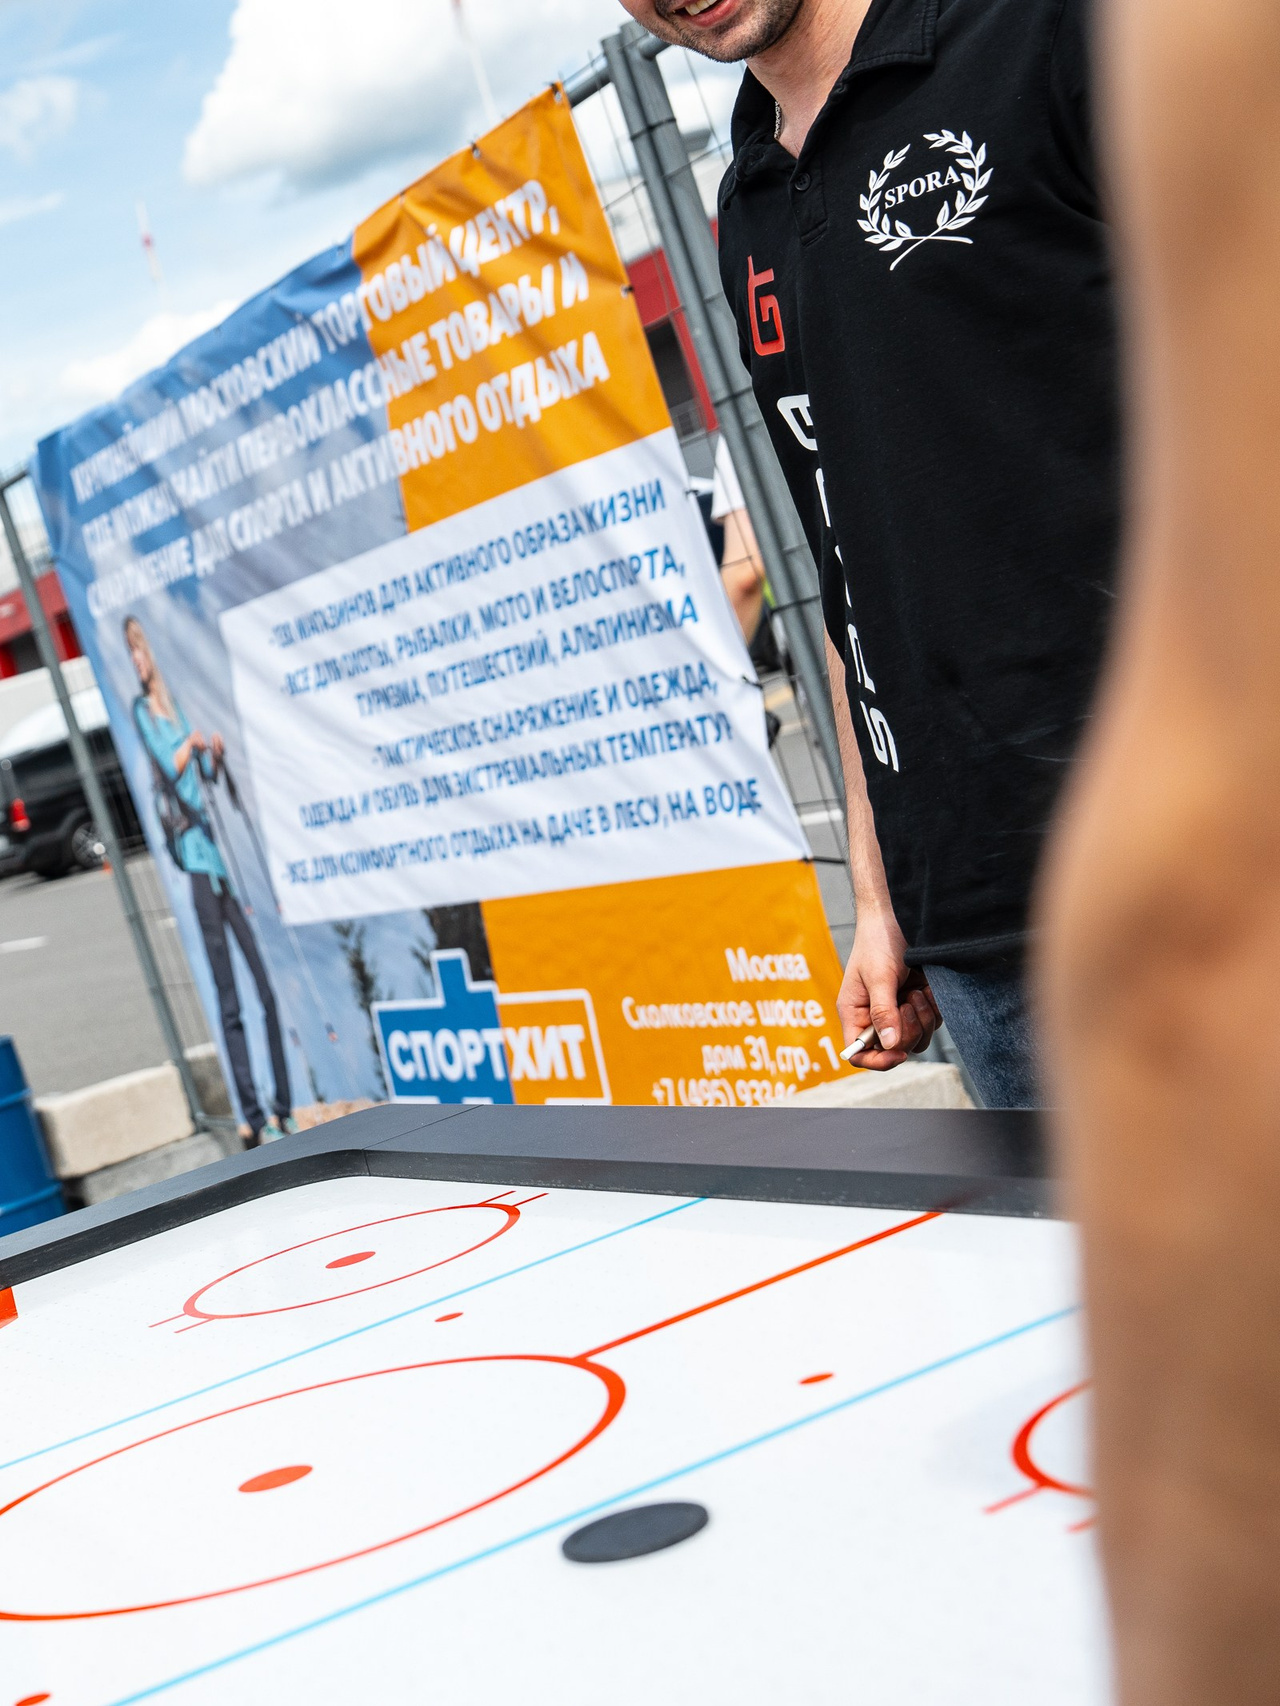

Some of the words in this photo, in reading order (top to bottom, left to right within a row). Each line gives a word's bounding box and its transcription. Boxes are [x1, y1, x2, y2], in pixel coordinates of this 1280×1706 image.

[884, 165, 961, 209] SPORA
[311, 222, 457, 354] ТОРГОВЫЙ
[448, 179, 560, 278] ЦЕНТР,
[237, 331, 437, 477] ПЕРВОКЛАССНЫЕ
[429, 263, 556, 370] ТОВАРЫ
[559, 251, 589, 309] И
[228, 479, 312, 551] СПОРТА
[307, 466, 332, 516] И
[329, 395, 479, 508] АКТИВНОГО
[476, 331, 610, 429] ОТДЫХА
[413, 537, 511, 595] АКТИВНОГО
[513, 508, 585, 559] ОБРАЗА
[478, 593, 533, 631] МОТО
[533, 583, 549, 615] И
[548, 543, 686, 610] ВЕЛОСПОРТА,
[482, 684, 603, 743] СНАРЯЖЕНИЕ
[604, 681, 622, 713] И
[623, 661, 718, 711] ОДЕЖДА,
[452, 736, 606, 797] ЭКСТРЕМАЛЬНЫХ
[449, 820, 520, 859] ОТДЫХА
[520, 817, 545, 843] НА
[547, 807, 595, 847] ДАЧЕ
[596, 804, 611, 833] В
[666, 789, 700, 822] НА
[703, 778, 763, 818] ВОДЕ
[724, 946, 811, 983] Москва
[386, 1024, 588, 1083] СПОРТХИТ
[621, 996, 756, 1030] Сколковское
[756, 999, 826, 1028] шоссе
[701, 1044, 748, 1076] дом
[818, 1035, 841, 1071] 1
